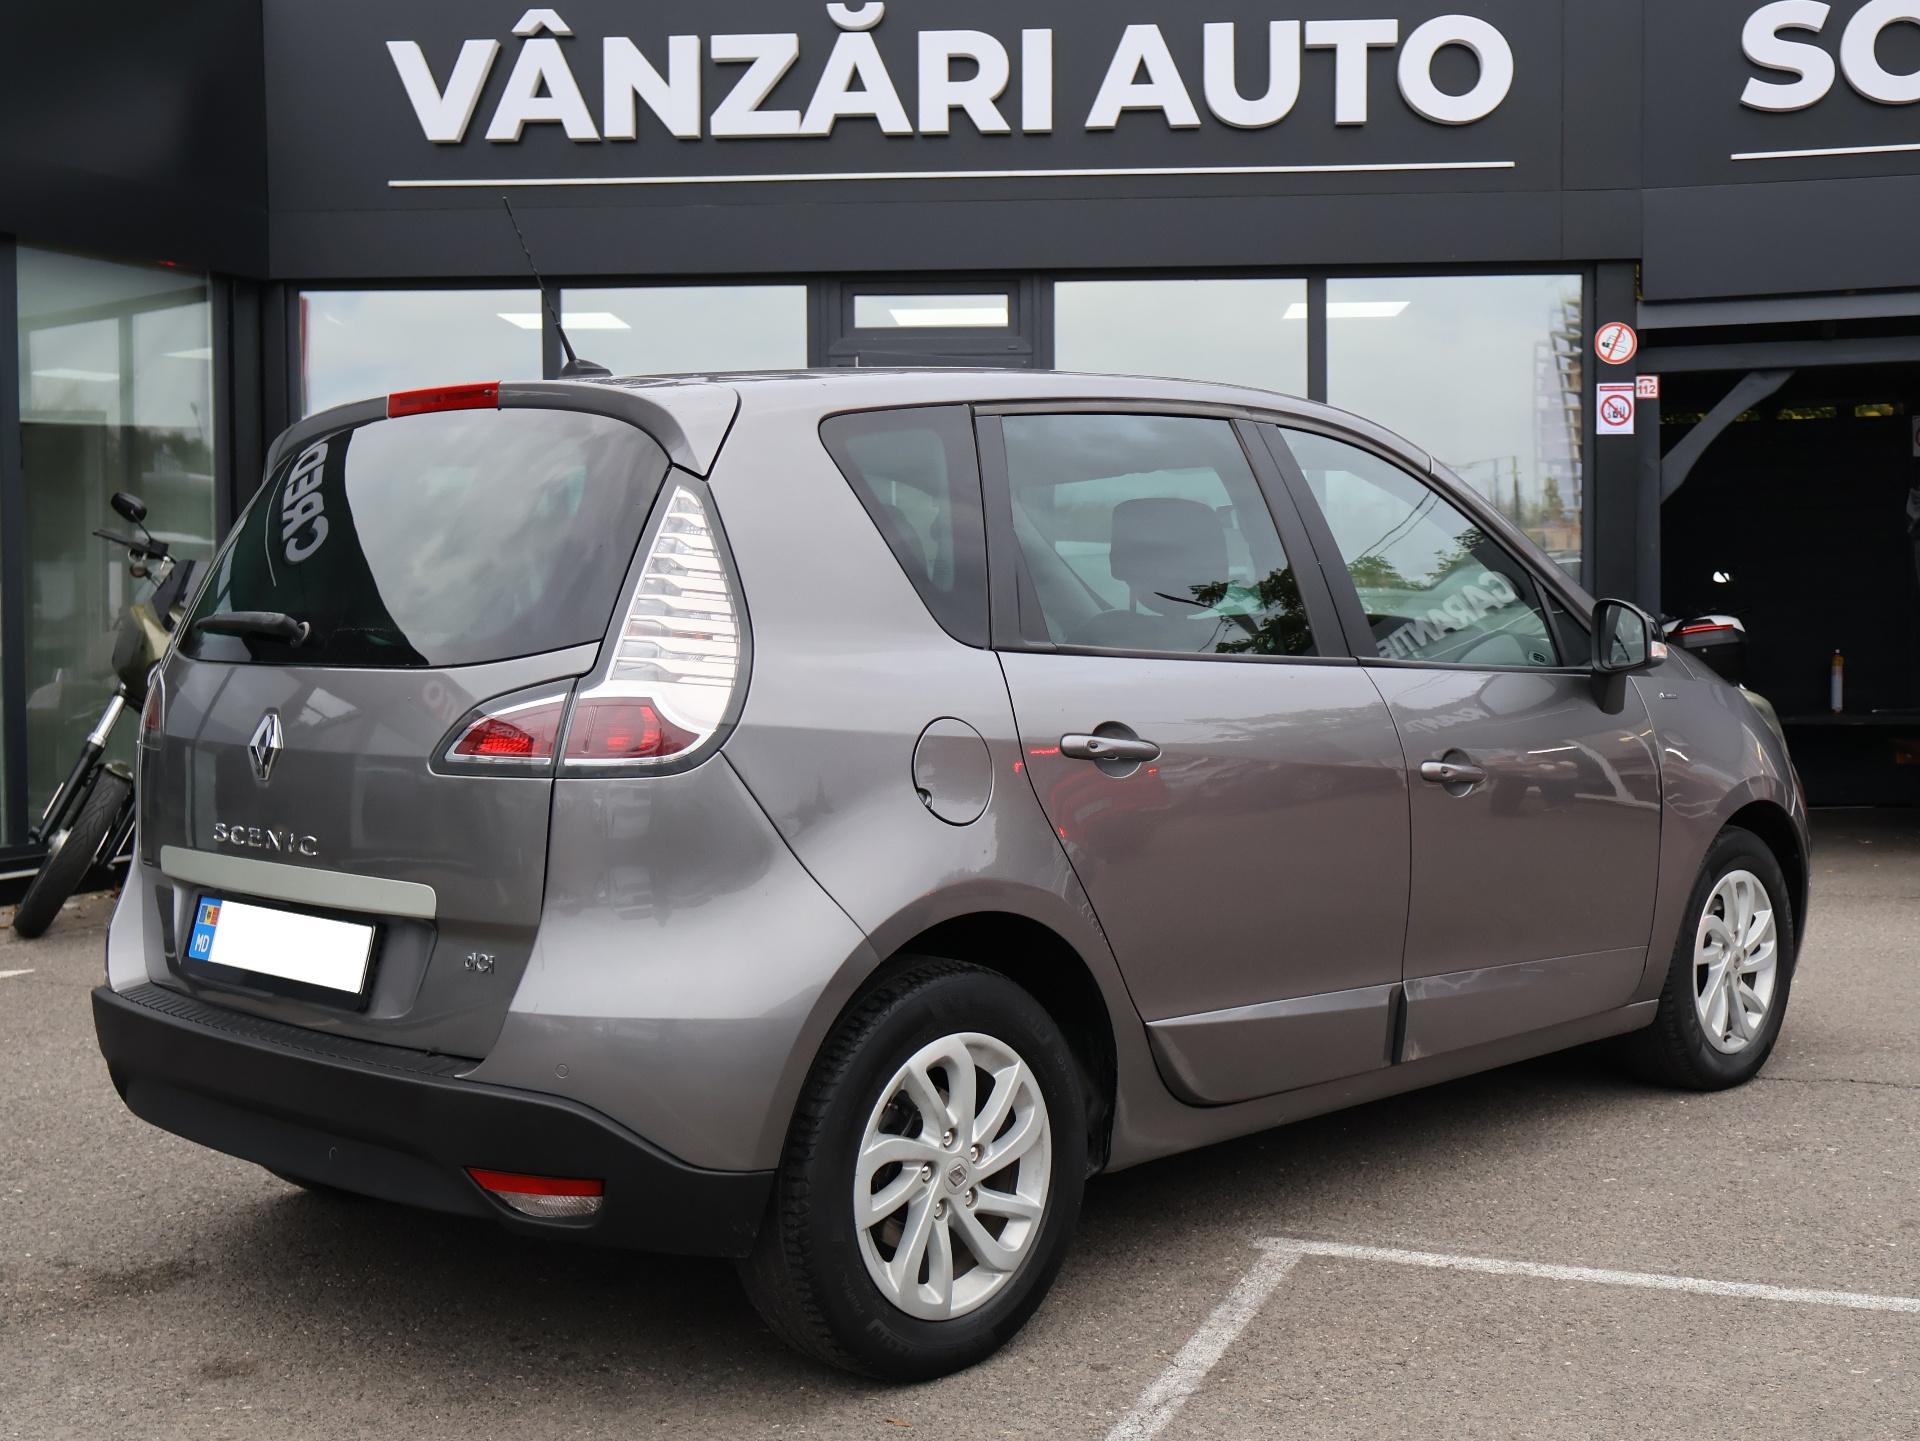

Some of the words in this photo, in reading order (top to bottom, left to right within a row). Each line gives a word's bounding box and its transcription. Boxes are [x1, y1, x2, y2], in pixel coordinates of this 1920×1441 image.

[386, 2, 1053, 144] VÂNZĂRI
[1085, 14, 1514, 130] AUTO
[1638, 384, 1656, 396] 112
[213, 822, 319, 856] SCENIC
[194, 934, 211, 953] MD
